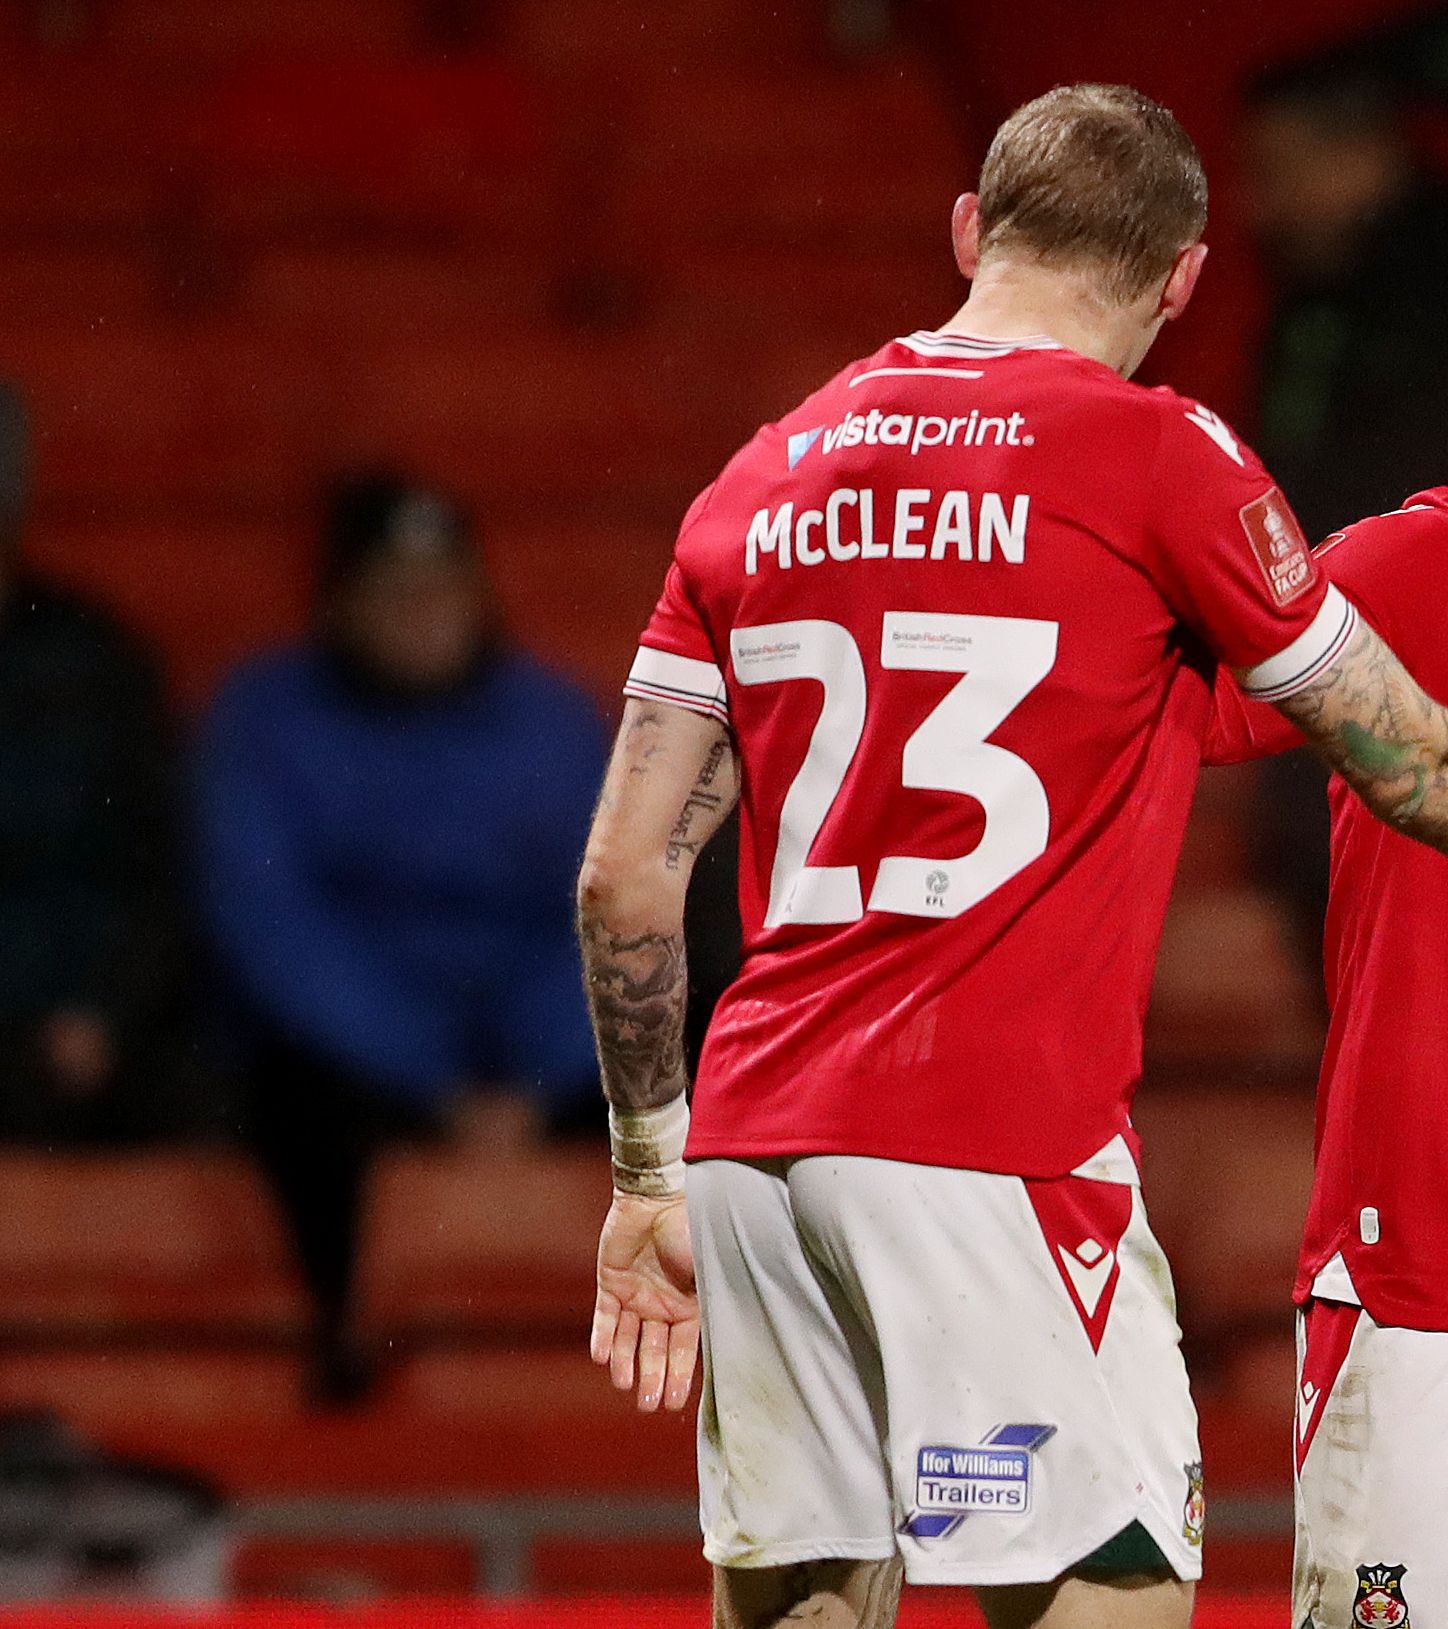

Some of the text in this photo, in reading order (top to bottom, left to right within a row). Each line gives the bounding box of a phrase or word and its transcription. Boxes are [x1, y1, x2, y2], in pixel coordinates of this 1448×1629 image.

[744, 487, 1031, 576] McCLEAN
[730, 610, 1059, 929] 23
[926, 897, 944, 907] EFL
[922, 1452, 1025, 1477] Ifor Williams
[922, 1481, 1021, 1505] Trailers
